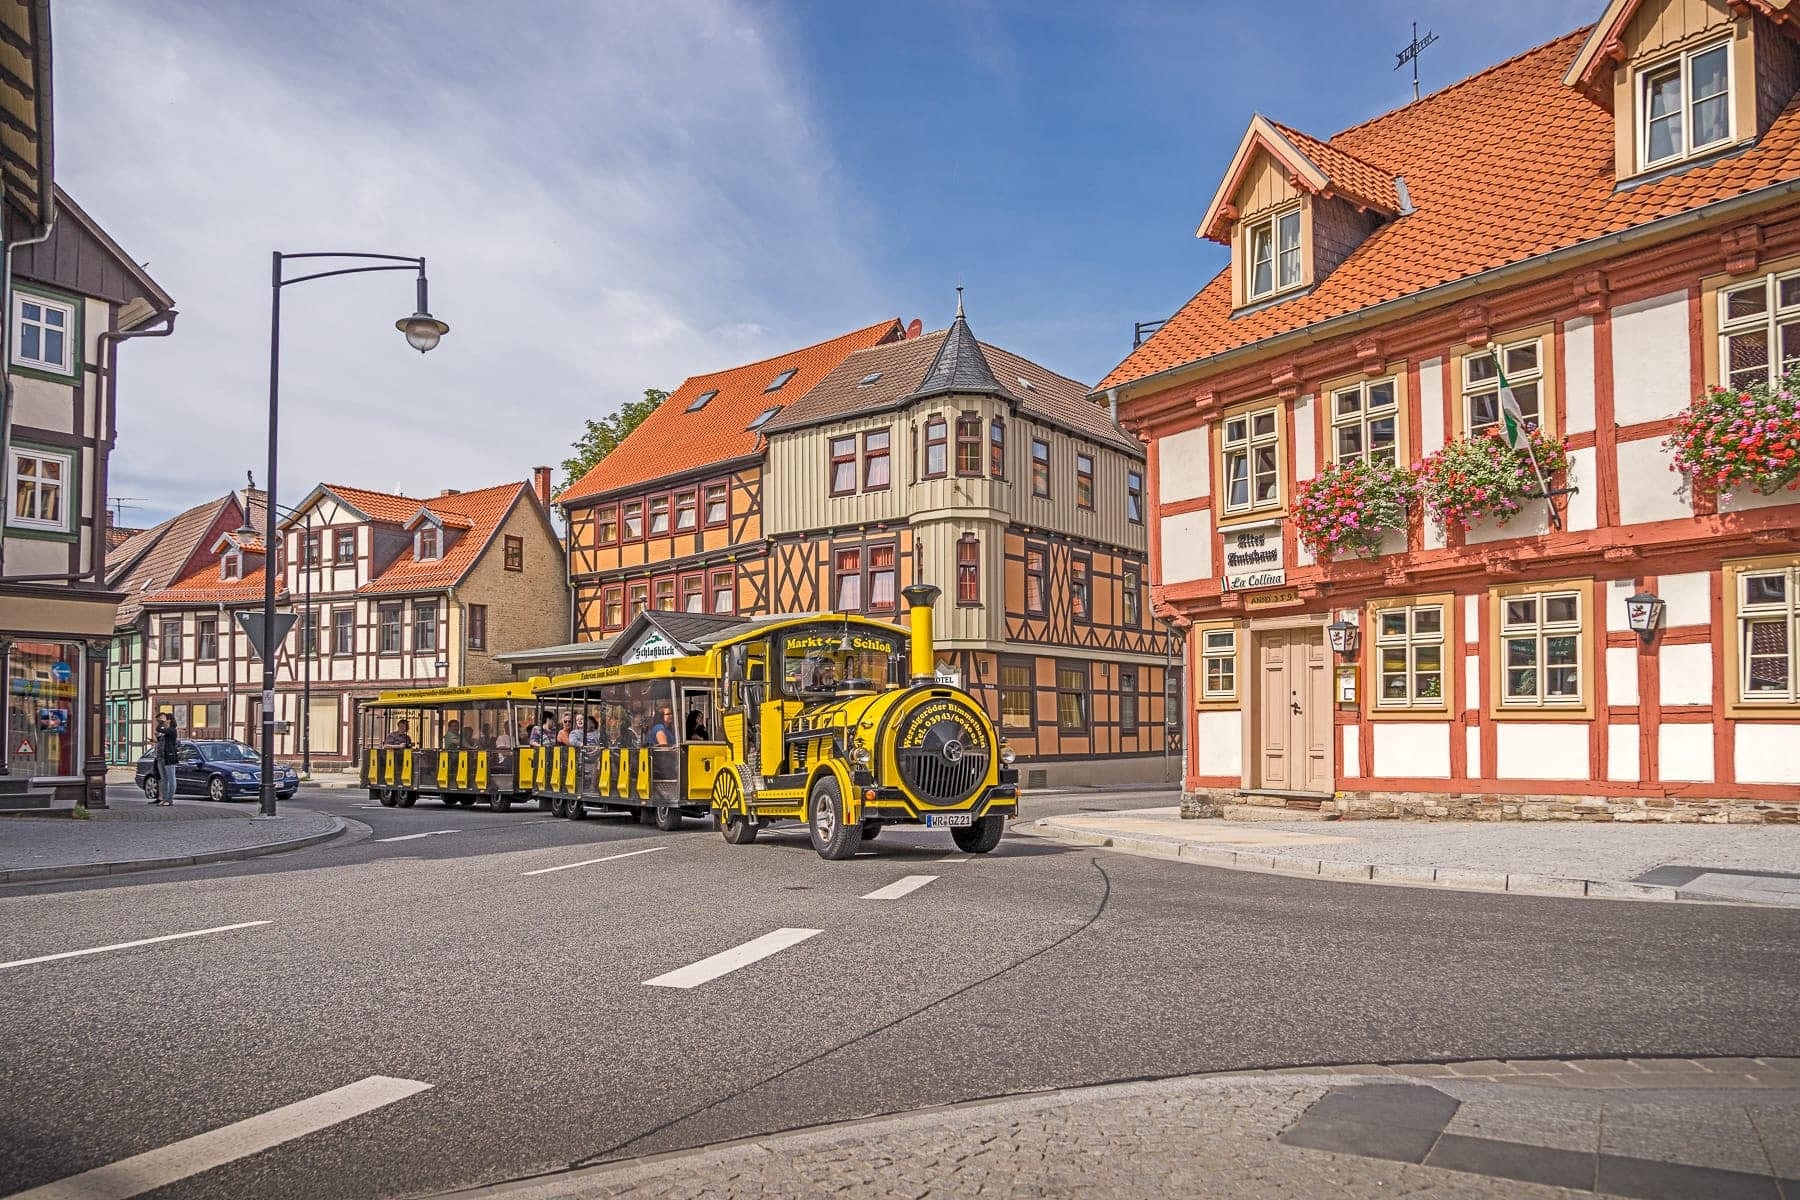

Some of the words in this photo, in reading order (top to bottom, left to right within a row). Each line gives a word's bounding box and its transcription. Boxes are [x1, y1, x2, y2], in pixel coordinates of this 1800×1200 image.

[1237, 533, 1265, 547] Altes
[1231, 576, 1246, 589] La
[1248, 573, 1282, 587] Collina
[787, 636, 823, 650] Markt
[853, 637, 891, 653] Schloß
[935, 676, 954, 684] OTEL
[903, 703, 947, 749] Wernigeröder
[948, 703, 987, 749] Bimmelbahn
[914, 728, 927, 745] Tel.
[932, 816, 943, 826] WR
